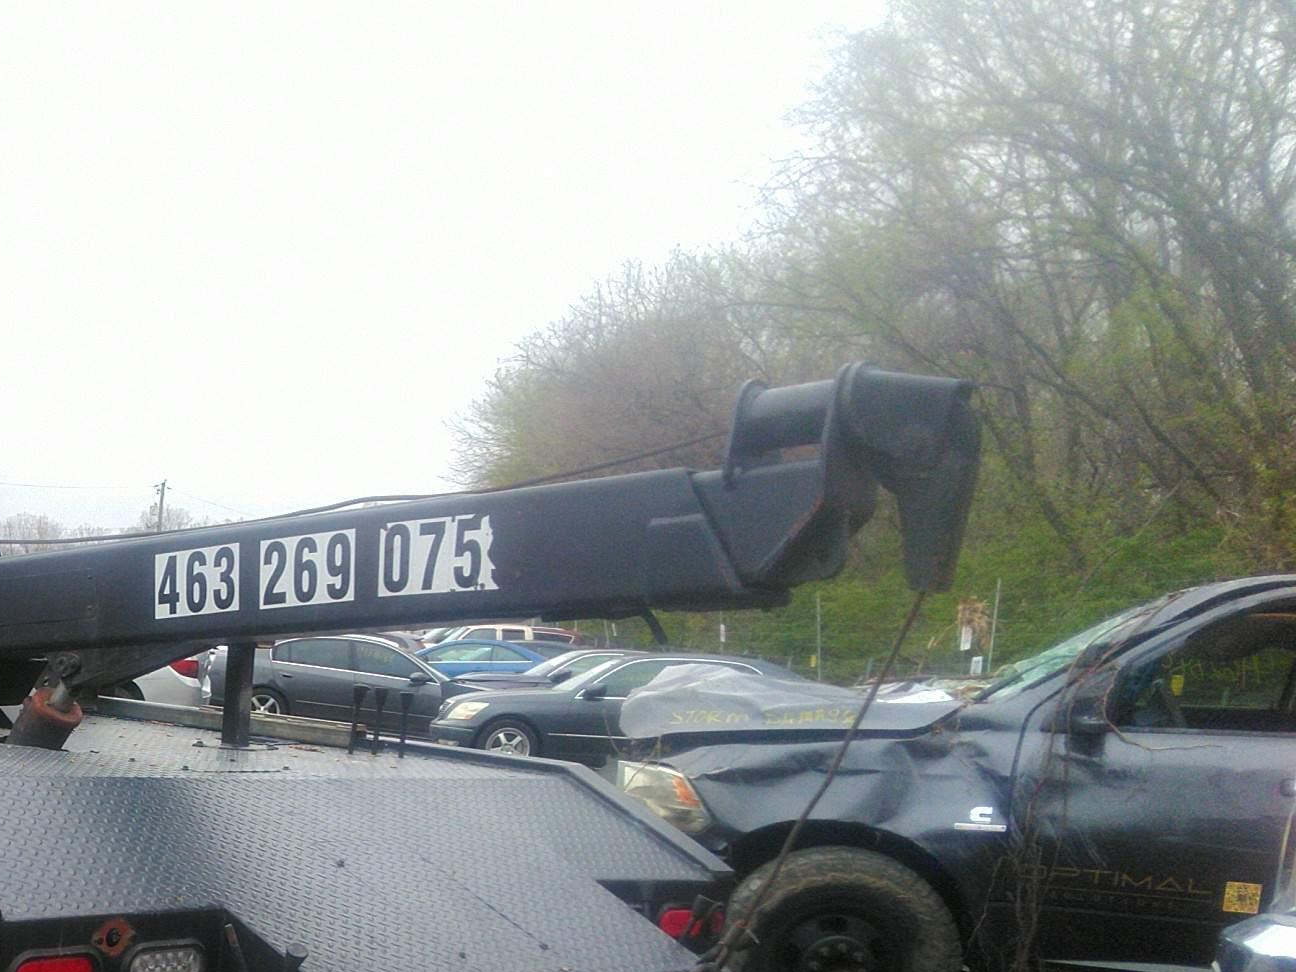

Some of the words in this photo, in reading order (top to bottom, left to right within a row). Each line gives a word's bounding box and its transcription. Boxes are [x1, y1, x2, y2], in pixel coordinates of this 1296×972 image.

[157, 545, 236, 615] 463
[262, 532, 353, 606] 269
[383, 515, 483, 594] 075
